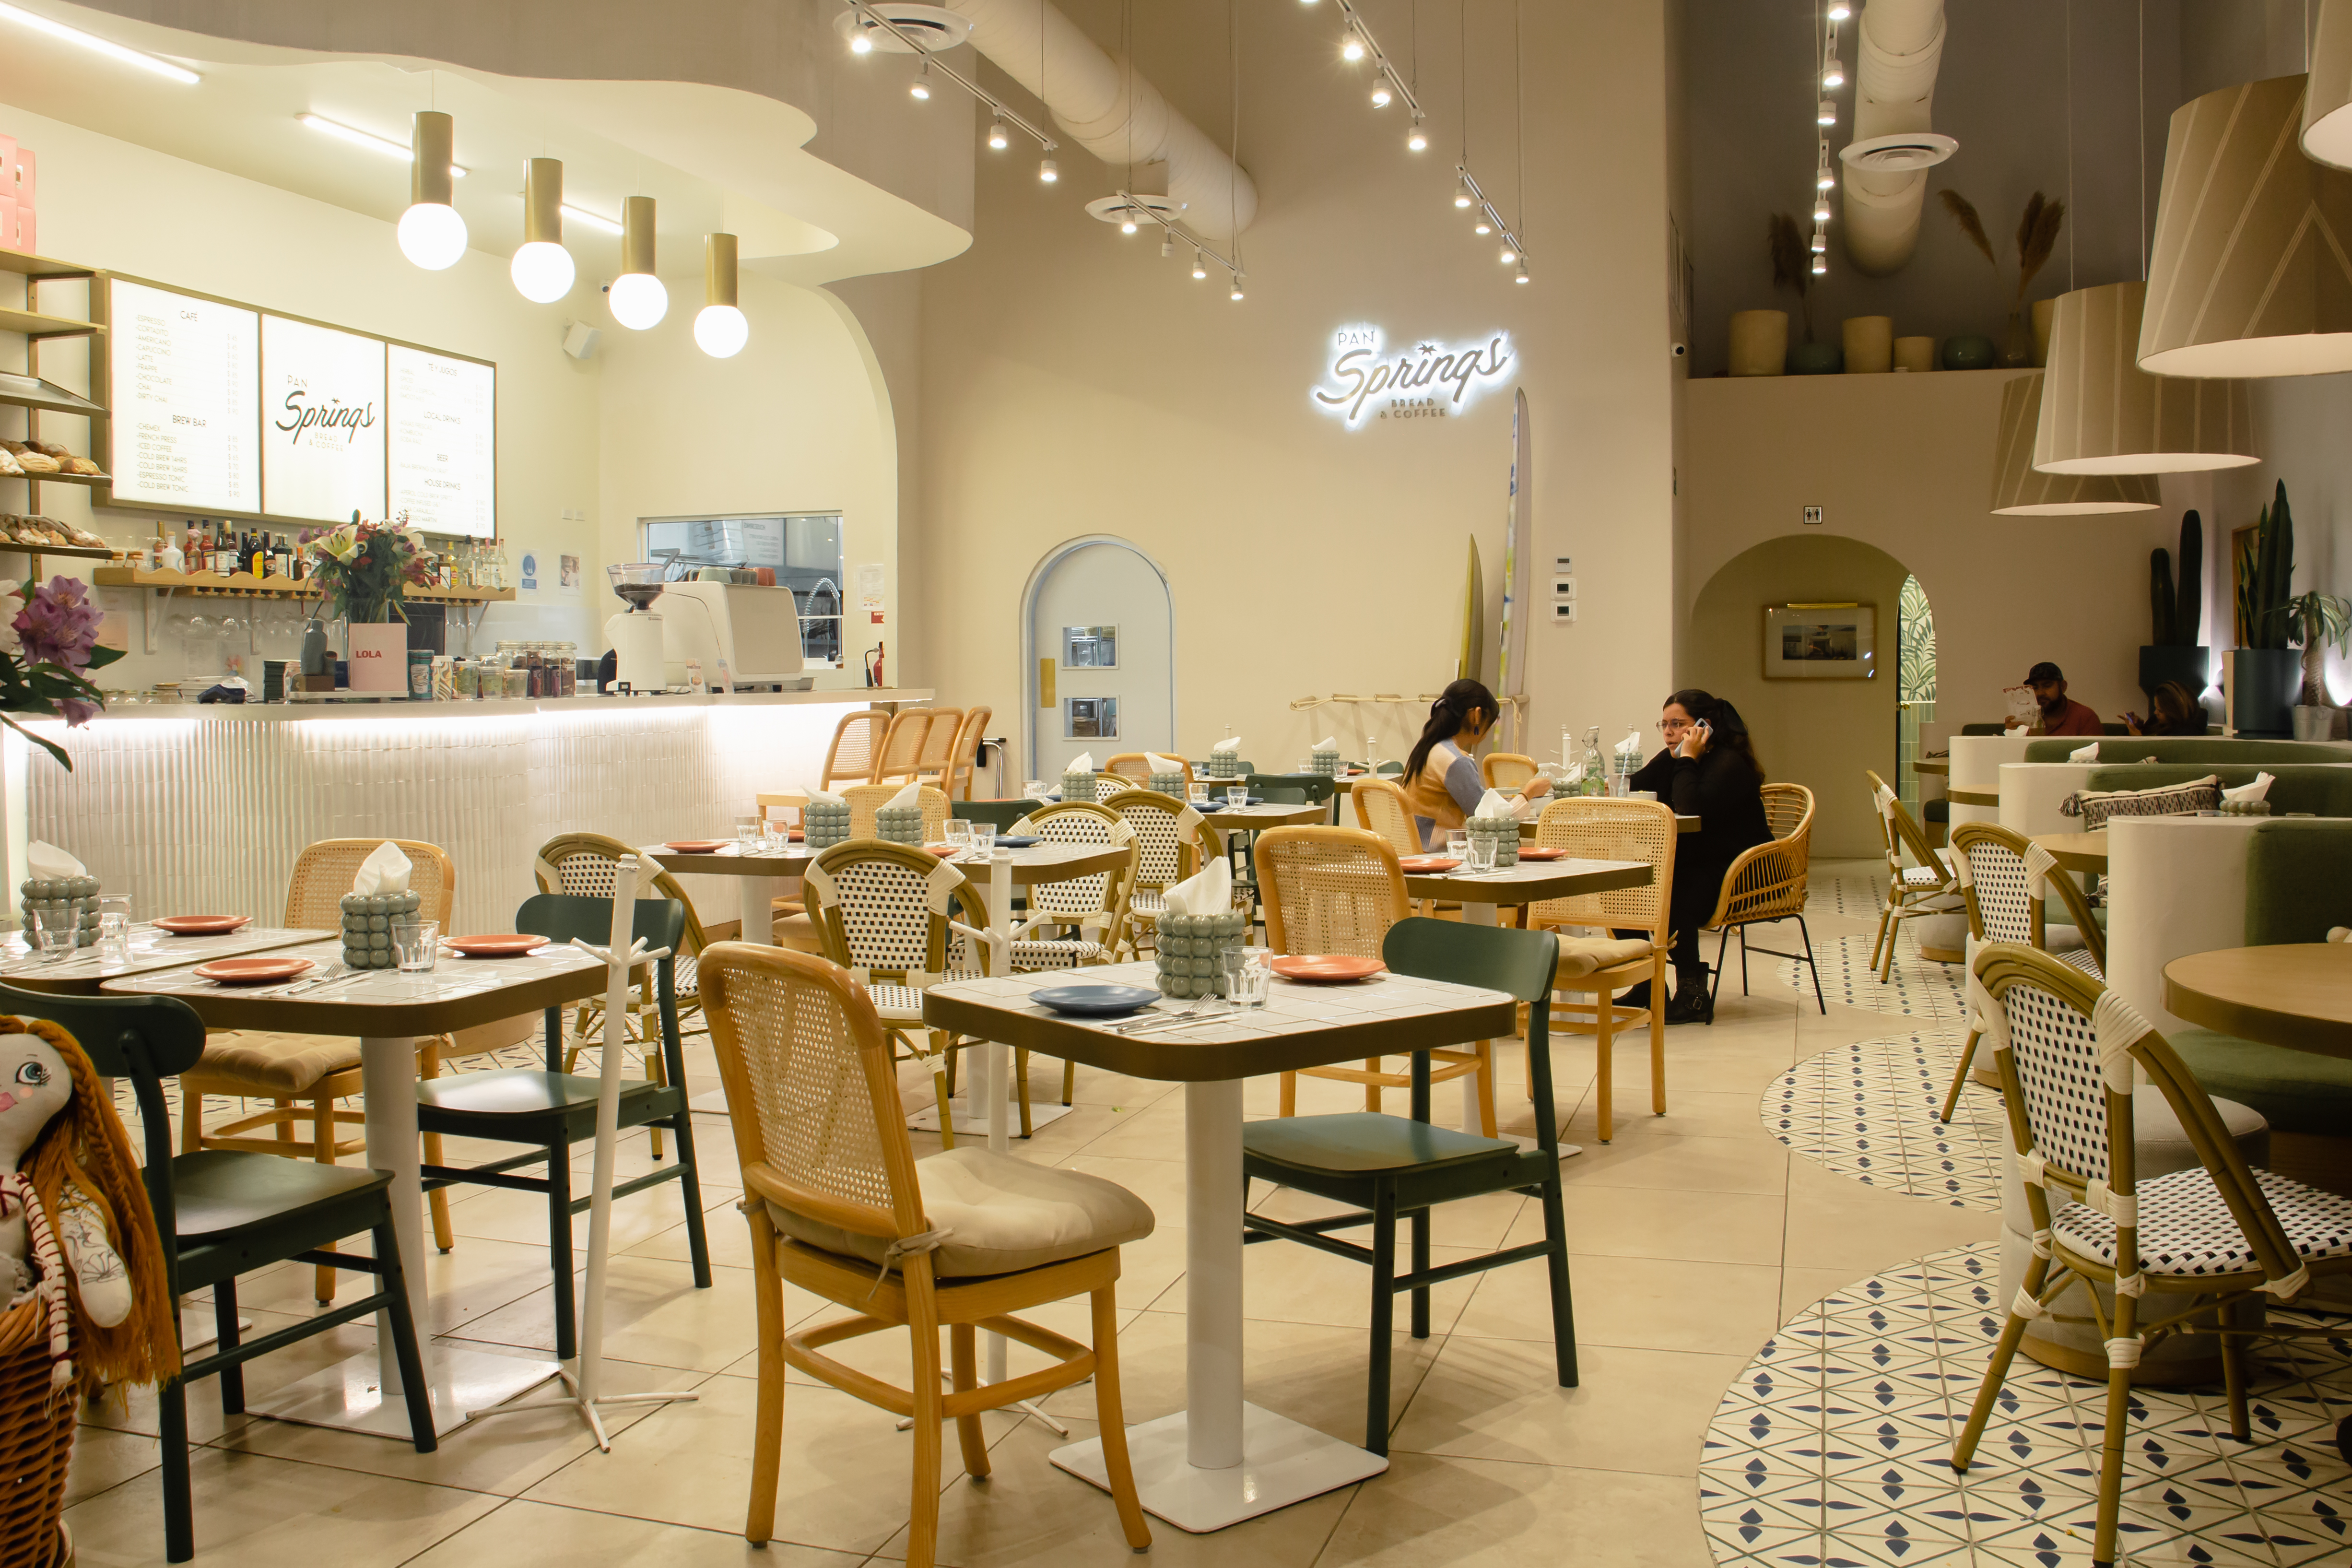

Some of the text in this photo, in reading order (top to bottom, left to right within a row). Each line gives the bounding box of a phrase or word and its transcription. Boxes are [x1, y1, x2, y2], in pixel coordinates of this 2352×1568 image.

[135, 315, 165, 326] -ESPRESSO
[180, 311, 198, 322] CAFÉ
[135, 325, 168, 336] -CORTADITO
[135, 335, 171, 347] -AMERICANO
[1338, 331, 1374, 346] PAN
[135, 344, 171, 356] -CAPUCCINO
[136, 354, 153, 363] -LATTE
[439, 366, 457, 377] JUGOS
[136, 373, 172, 385] -CHOCOLATE
[288, 375, 308, 388] PAN
[1316, 338, 1508, 420] Springs
[154, 395, 167, 403] CHAI
[1391, 398, 1434, 408] BREAD
[275, 390, 375, 445] Springs
[423, 411, 461, 425] LOCAL DRINKS
[1380, 408, 1446, 419] & COFFEE
[173, 415, 207, 428] BREW BAR
[161, 436, 177, 444] PRESS
[315, 432, 338, 442] BREAD
[152, 444, 172, 452] COFFEE
[316, 441, 344, 452] COFFEE
[437, 454, 448, 462] BEER
[168, 474, 185, 483] TONIC
[172, 484, 188, 493] TONIC
[424, 479, 461, 490] HOUSE DRINKS
